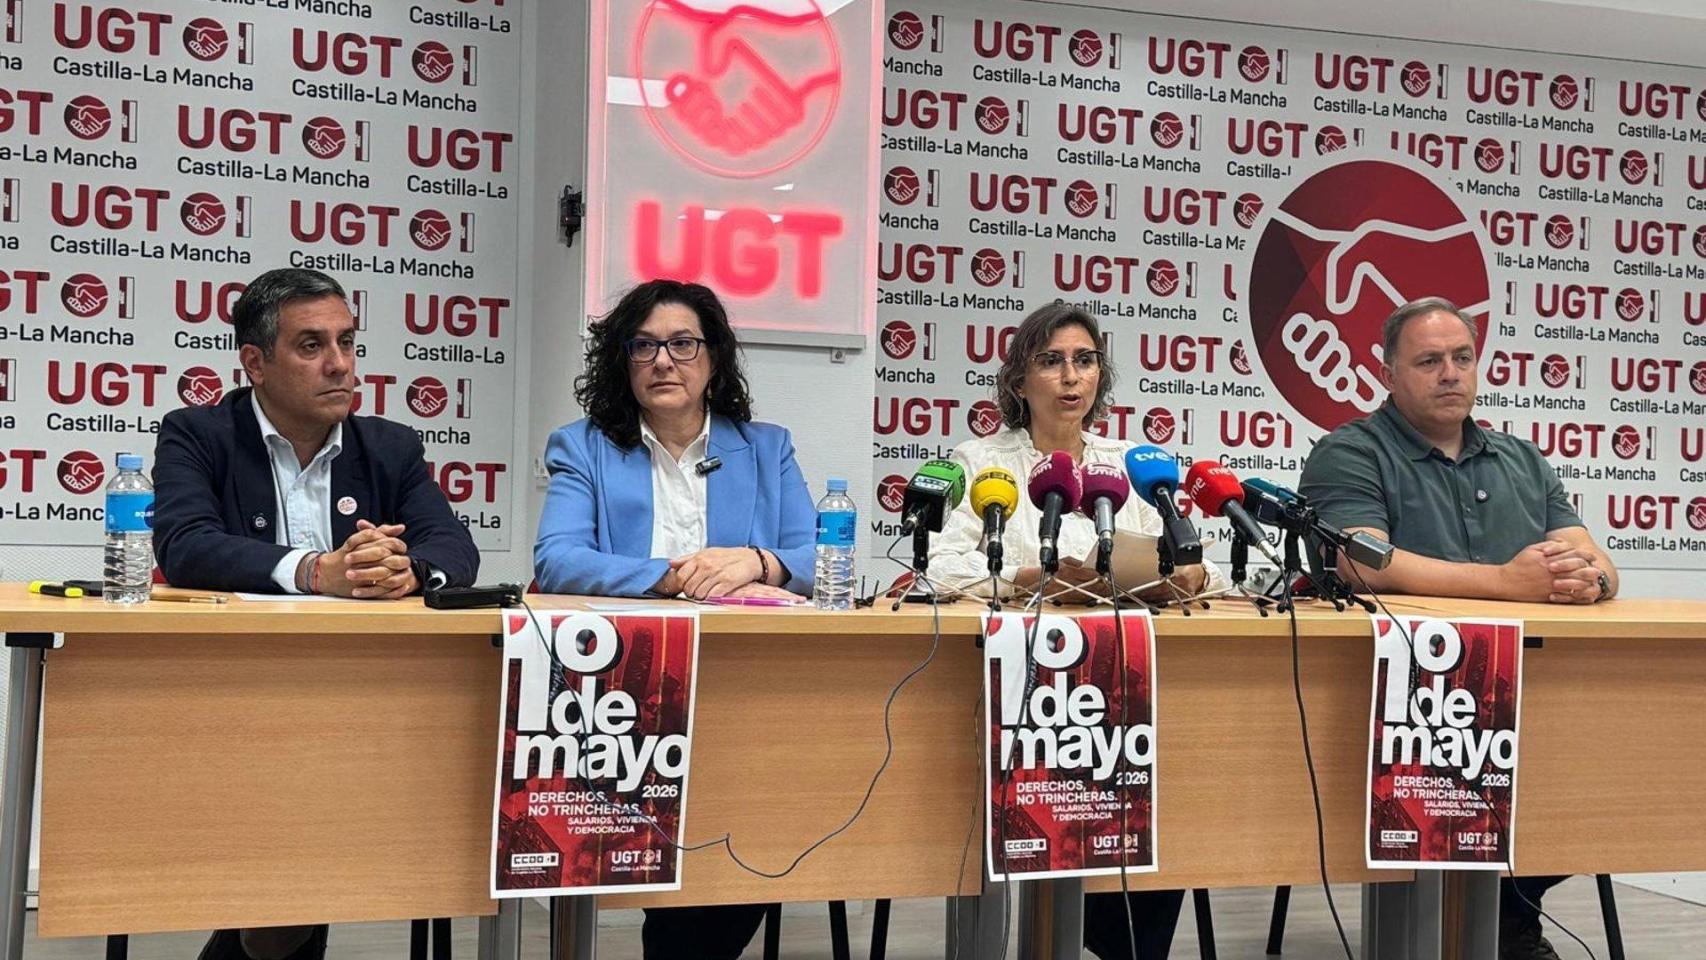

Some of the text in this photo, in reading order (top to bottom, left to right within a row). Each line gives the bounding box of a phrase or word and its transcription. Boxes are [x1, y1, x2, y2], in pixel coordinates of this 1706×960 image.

[295, 0, 371, 18] Mancha
[409, 6, 511, 32] Castilla-La
[54, 3, 172, 56] UGT
[974, 19, 1061, 63] UGT
[293, 28, 402, 78] UGT
[1149, 36, 1231, 79] UGT
[54, 57, 253, 91] Castilla-La Mancha
[883, 57, 943, 76] Mancha
[973, 65, 1120, 92] Castilla-La Mancha
[1315, 52, 1394, 93] UGT
[293, 79, 476, 112] Castilla-La Mancha
[1148, 81, 1286, 107] Castilla-La Mancha
[1467, 67, 1543, 107] UGT
[882, 87, 967, 131] UGT
[1314, 96, 1446, 121] Castilla-La Mancha
[1619, 81, 1691, 120] UGT
[178, 105, 292, 154] UGT
[1059, 103, 1143, 145] UGT
[1467, 109, 1593, 133] Castilla-La Mancha
[1618, 122, 1687, 141] Castilla-La
[408, 125, 513, 173] UGT
[880, 134, 1027, 160] Castilla-La Mancha
[1228, 118, 1308, 158] UGT
[54, 147, 136, 169] Mancha
[1058, 148, 1200, 173] Castilla-La Mancha
[1227, 161, 1291, 179] Castilla-
[1540, 143, 1613, 182] UGT
[178, 157, 369, 188] Castilla-La Mancha
[408, 175, 508, 199] Castilla-La
[970, 172, 1057, 215] UGT
[1467, 179, 1520, 197] Mancha
[1539, 185, 1662, 207] Castilla-La Mancha
[51, 182, 170, 231] UGT
[1144, 186, 1226, 226] UGT
[291, 200, 400, 247] UGT
[879, 213, 939, 230] Mancha
[969, 218, 1115, 242] Castilla-La Mancha
[1480, 210, 1538, 246] GT
[51, 235, 250, 264] Castilla-La Mancha
[1143, 230, 1221, 249] Castilla-La
[1615, 219, 1687, 256] UGT
[636, 202, 843, 299] UGT
[1495, 252, 1589, 272] lla-La Mancha
[289, 251, 473, 279] Castilla-La Mancha
[878, 243, 963, 284] UGT
[1055, 253, 1139, 294] UGT
[1614, 260, 1682, 278] Castilla-La
[175, 280, 248, 323] UG
[877, 289, 1024, 311] Castilla-La Mancha
[1139, 303, 1196, 320] Mancha
[1536, 283, 1609, 320] UGT
[405, 293, 510, 338] UGT
[51, 325, 133, 346] Mancha
[1535, 324, 1605, 341] Castilla-La
[1609, 328, 1659, 343] Mancha
[405, 343, 504, 364] Castilla-La
[1140, 334, 1222, 373] UGT
[875, 367, 935, 384] Mancha
[1486, 350, 1534, 387] GT
[1611, 357, 1683, 393] UGT
[48, 361, 167, 407] UGT
[1140, 378, 1265, 398] Castilla-La Manc
[1474, 394, 1585, 410] stilla-La Mancha
[1611, 398, 1679, 414] Castilla-La
[47, 413, 160, 433] Castilla-La
[874, 397, 959, 436] UGT
[416, 427, 470, 444] ancha
[1532, 422, 1605, 458] UGT
[1134, 451, 1171, 462] tve
[1219, 454, 1296, 471] Castilla-La
[427, 461, 506, 503] GT
[1556, 466, 1655, 480] tilla-La Mancha
[47, 504, 104, 520] Manc
[1608, 495, 1680, 530] UGT
[872, 520, 902, 537] Man
[1608, 536, 1706, 554] Castilla-La Man
[551, 675, 637, 734] de
[1030, 671, 1105, 727] de
[1410, 675, 1476, 728] de
[513, 734, 688, 792] mayo
[1001, 724, 1154, 781] mayo
[1381, 724, 1516, 780] mayo
[1016, 780, 1086, 793] DERECHOS,
[1116, 771, 1148, 785] 2026
[1394, 776, 1455, 789] DERECHOS,
[1481, 774, 1510, 787] 2026
[529, 791, 608, 804] DERECHOS,
[642, 784, 679, 798] 2026
[1016, 795, 1035, 806] NO
[1393, 788, 1410, 799] NO
[528, 804, 549, 817] NO
[1059, 812, 1113, 821] DEMOCRACIA
[1095, 802, 1132, 811] VIVIENA
[1430, 809, 1477, 817] DEMOCRACIA
[1462, 801, 1495, 809] VIVIEN
[567, 825, 635, 835] Y DEMOCRACIA
[1093, 835, 1119, 848] UGT
[1458, 832, 1481, 845] UGT
[611, 850, 640, 864] UGT
